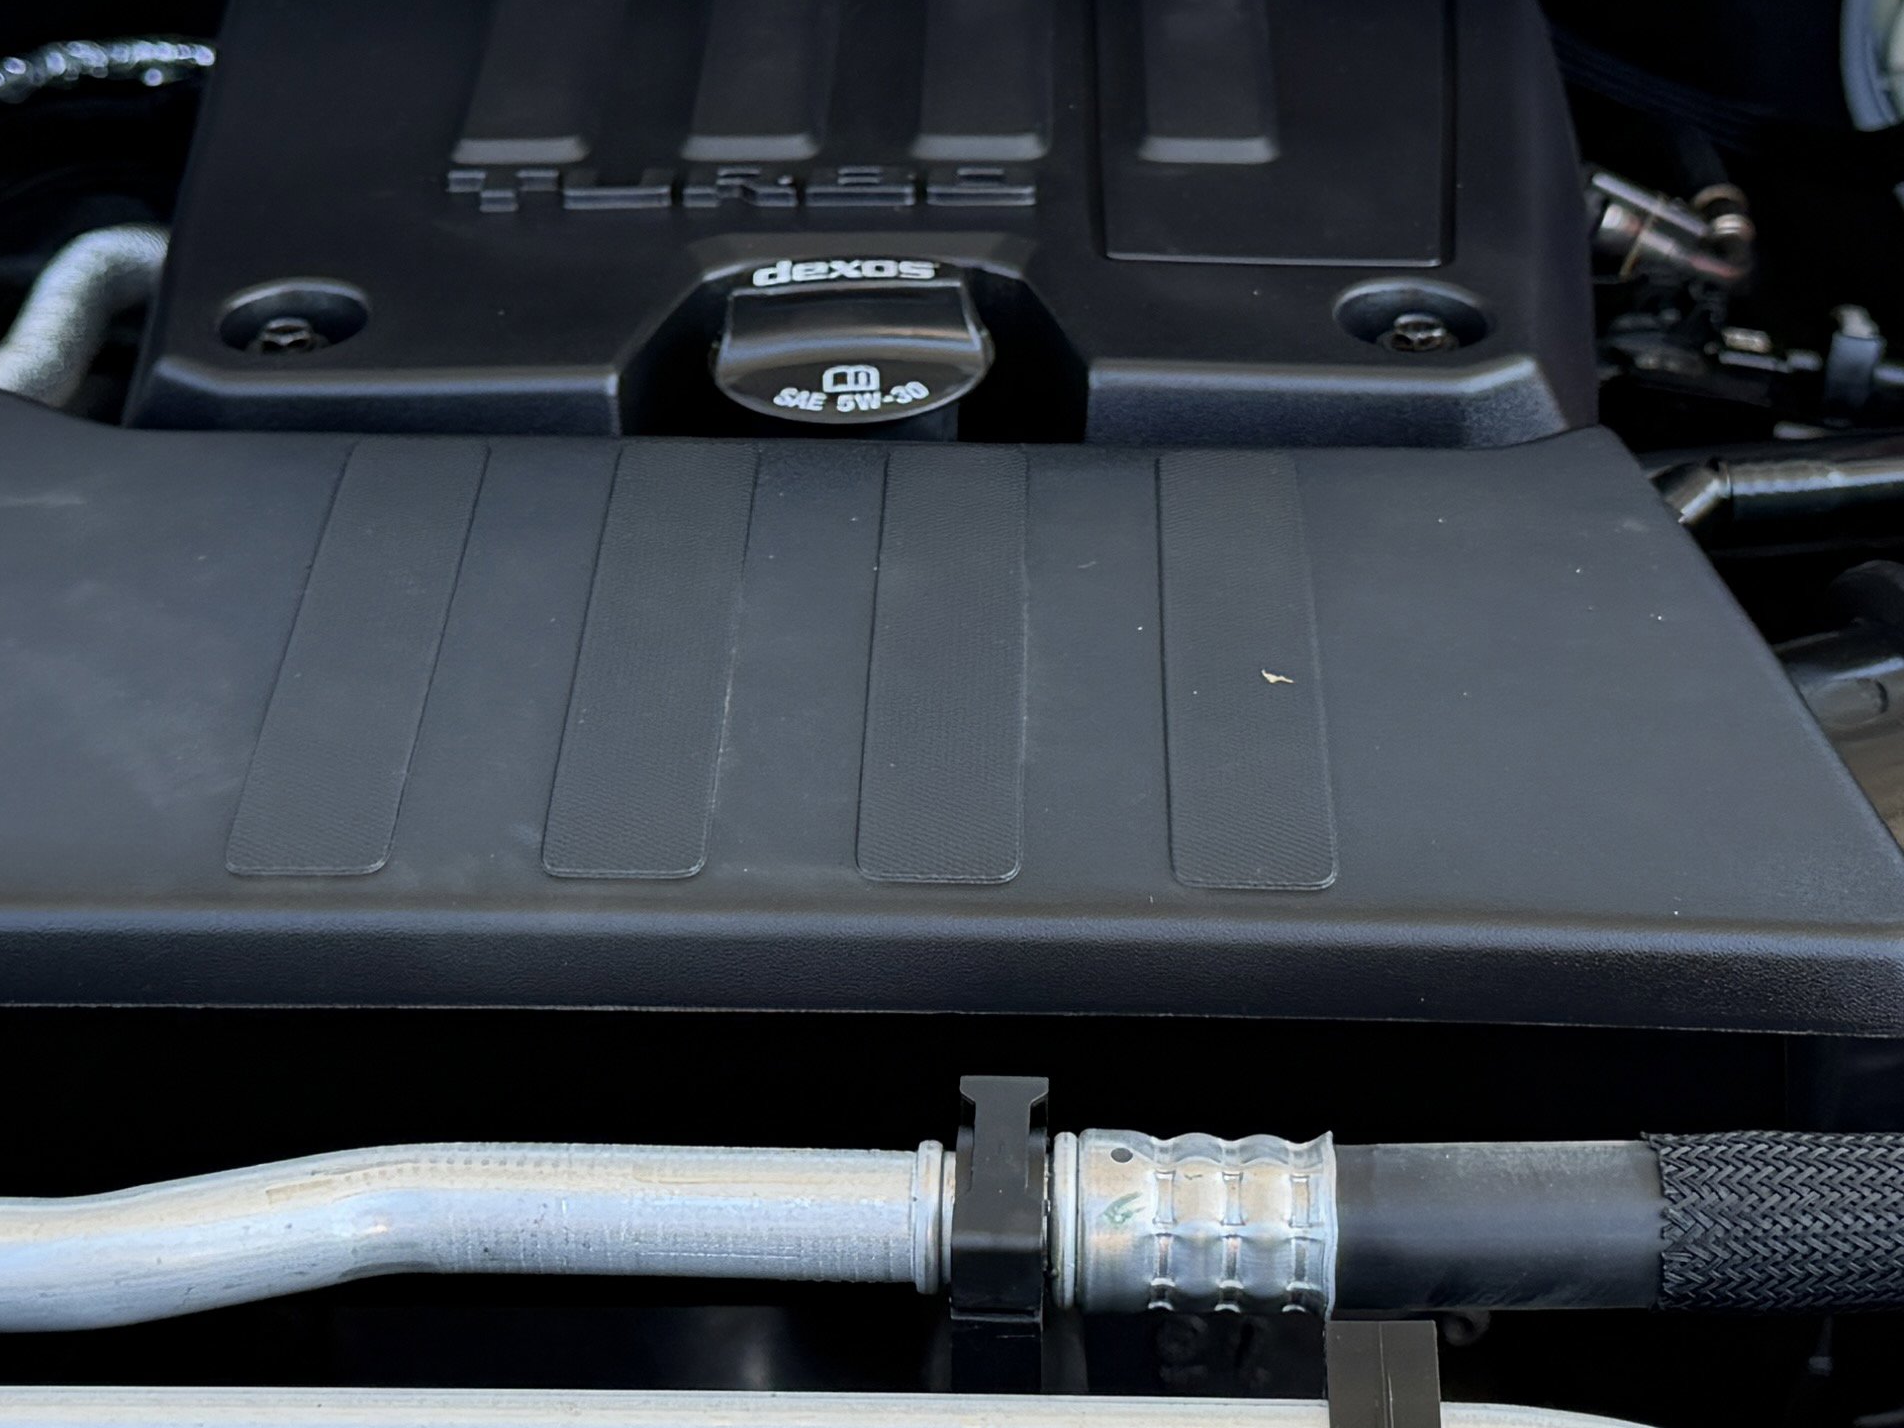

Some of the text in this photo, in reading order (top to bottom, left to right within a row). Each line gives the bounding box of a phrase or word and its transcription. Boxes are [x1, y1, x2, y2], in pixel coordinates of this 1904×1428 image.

[447, 168, 1037, 213] TURBO
[752, 259, 936, 287] dexos
[772, 380, 930, 413] SAE 5W-30
